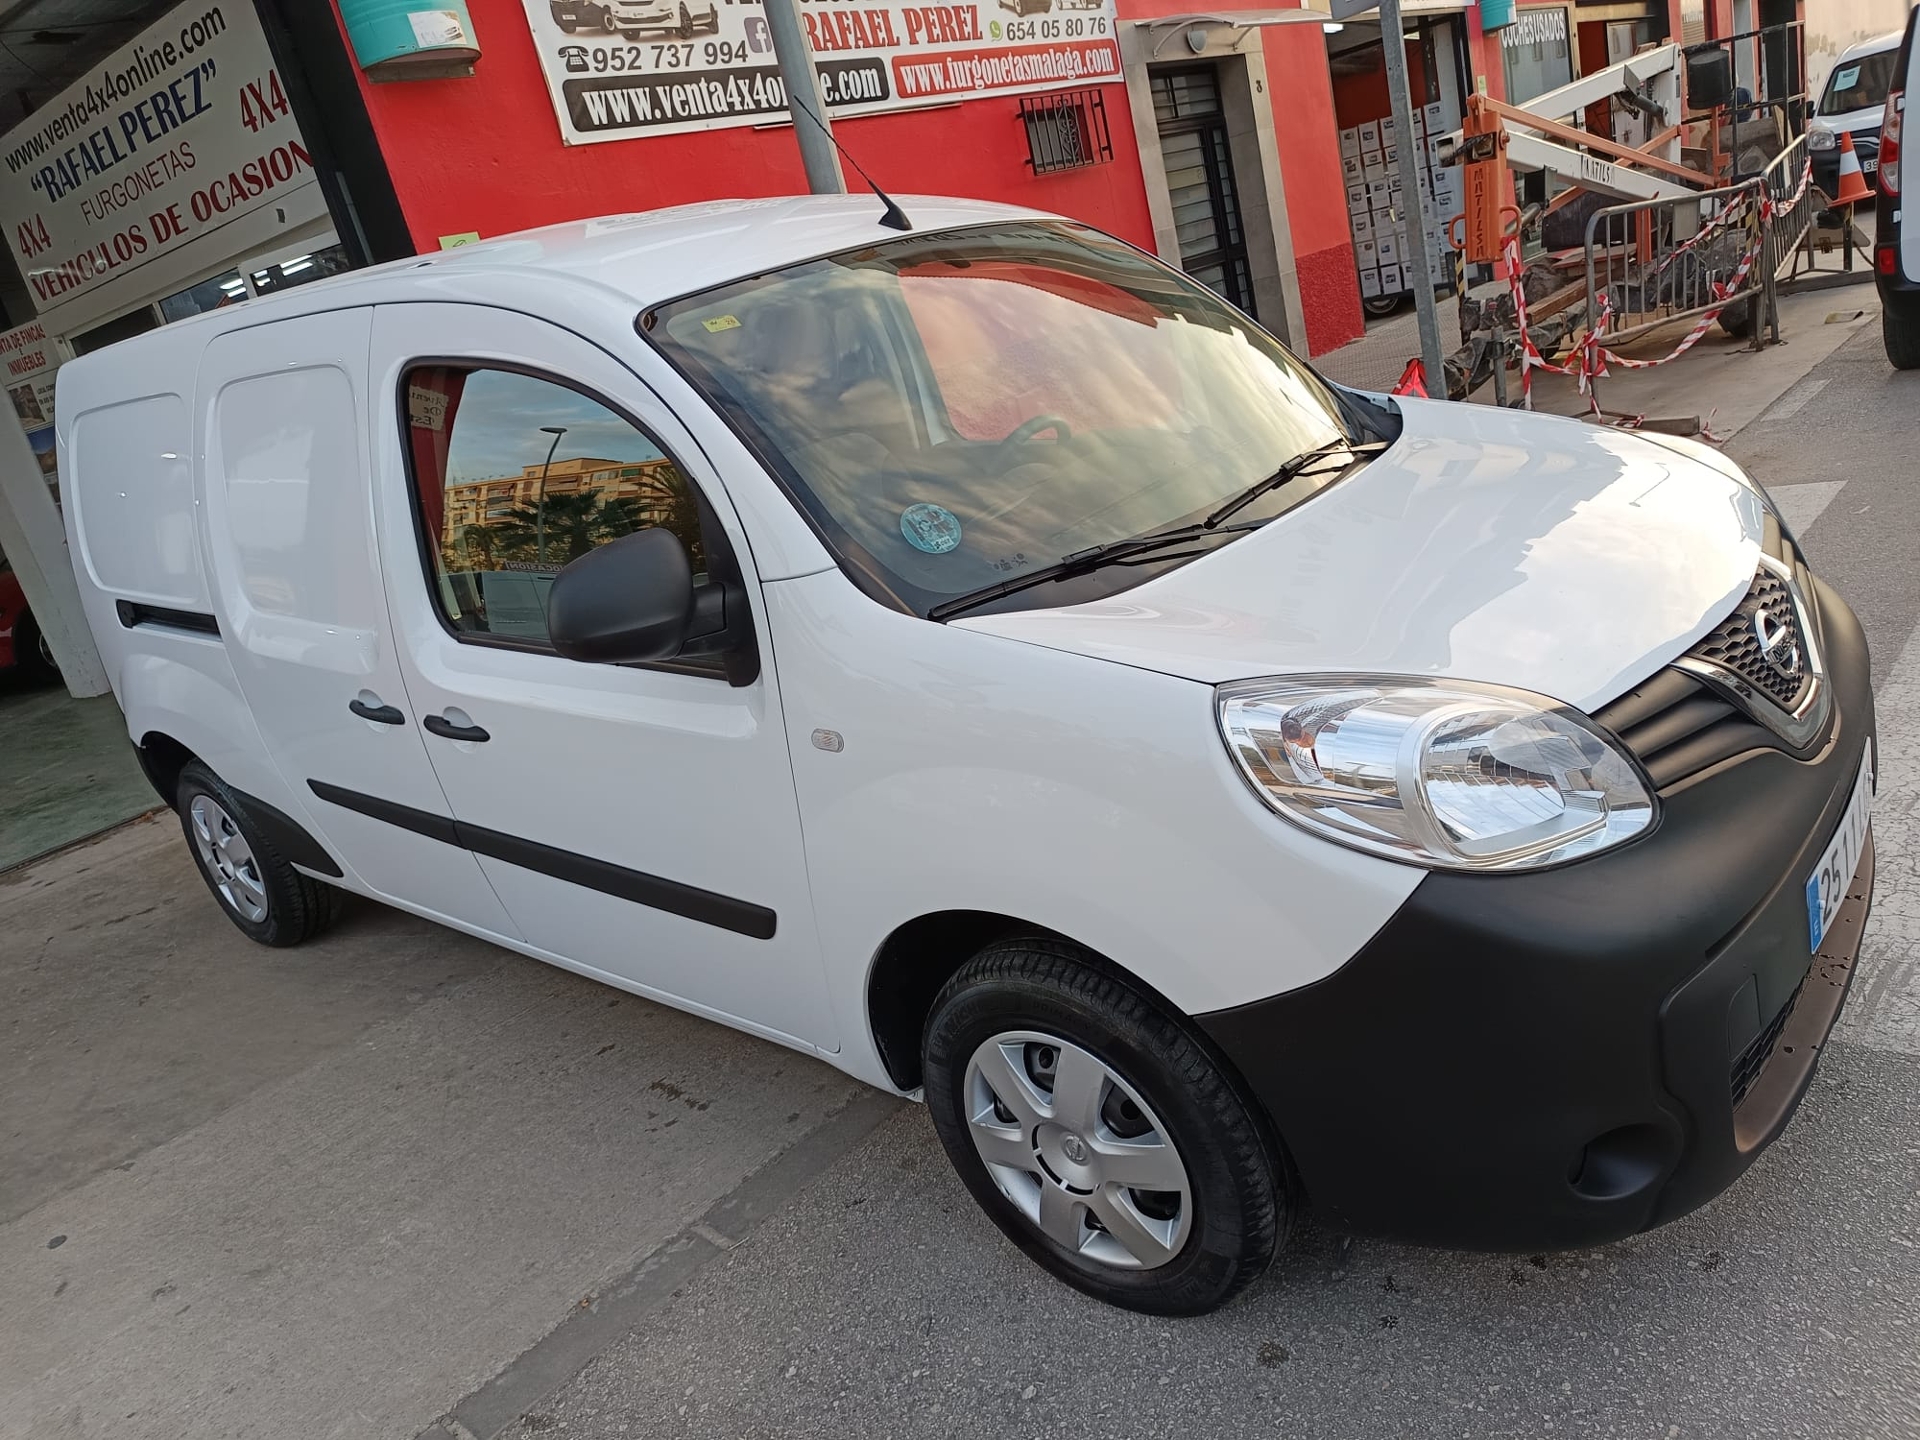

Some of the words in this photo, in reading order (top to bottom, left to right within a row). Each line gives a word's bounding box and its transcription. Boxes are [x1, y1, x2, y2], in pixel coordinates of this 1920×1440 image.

[802, 9, 900, 52] RAFAEL
[902, 4, 984, 46] PEREZ
[1006, 20, 1036, 41] 654
[1041, 19, 1060, 38] 05
[1065, 18, 1084, 37] 80
[1089, 16, 1107, 35] 76
[592, 46, 642, 73] 952
[650, 43, 695, 69] 737
[704, 40, 749, 66] 994
[899, 46, 1115, 94] www.furgonetasmalaga.com
[4, 6, 227, 174] www.venta4x4online.com
[80, 141, 197, 226] FURGONETAS
[31, 225, 148, 302] VEHICULOS
[148, 202, 189, 246] DE
[190, 139, 315, 223] OCASION
